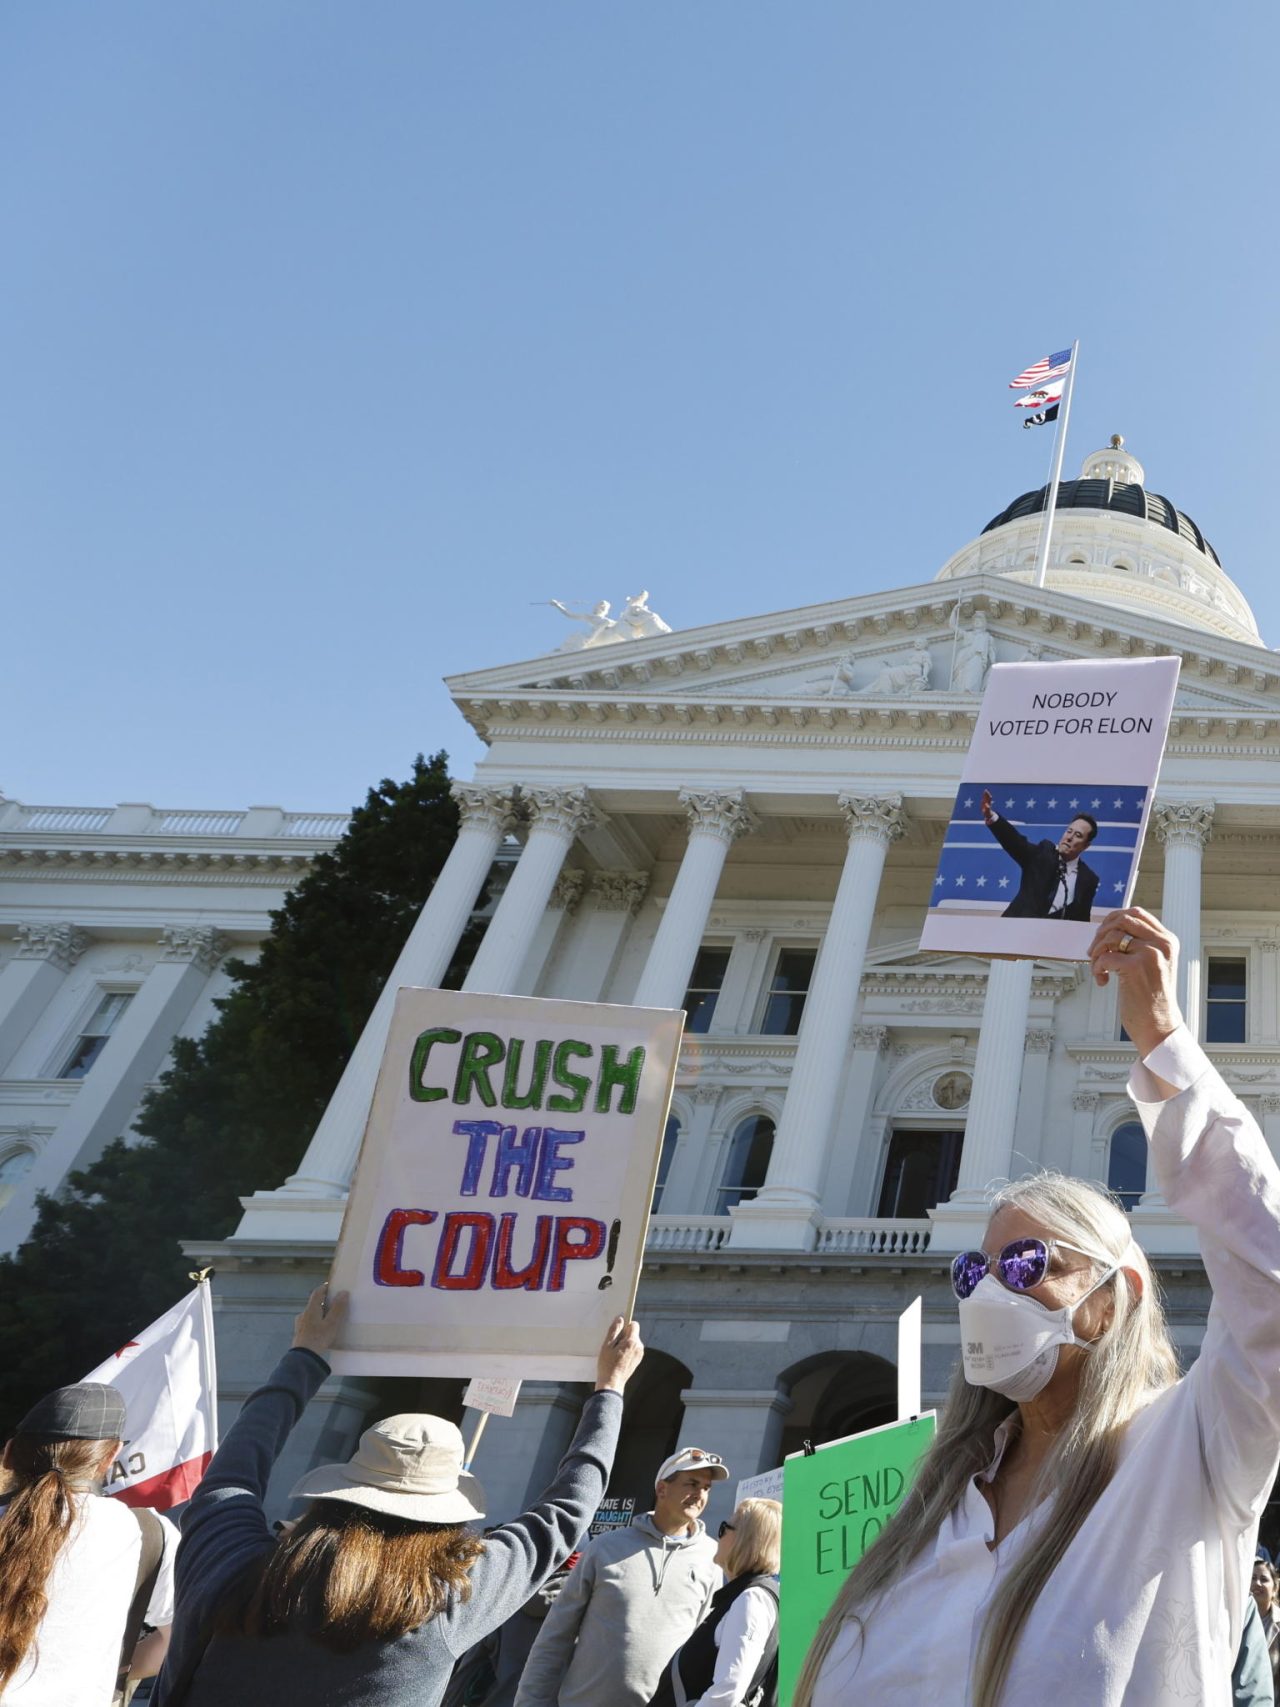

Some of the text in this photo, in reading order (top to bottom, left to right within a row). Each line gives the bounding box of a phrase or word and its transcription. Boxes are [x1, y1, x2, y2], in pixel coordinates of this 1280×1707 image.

[1032, 691, 1118, 710] NOBODY
[989, 717, 1153, 737] VOTED FOR ELON
[409, 1026, 646, 1115] CRUSH
[452, 1119, 586, 1202] THE
[372, 1207, 622, 1293] COUP!
[967, 1342, 984, 1354] 3M
[622, 1498, 632, 1510] IS
[818, 1466, 906, 1520] SEND
[595, 1511, 630, 1521] TAUGHT
[816, 1514, 892, 1575] ELO
